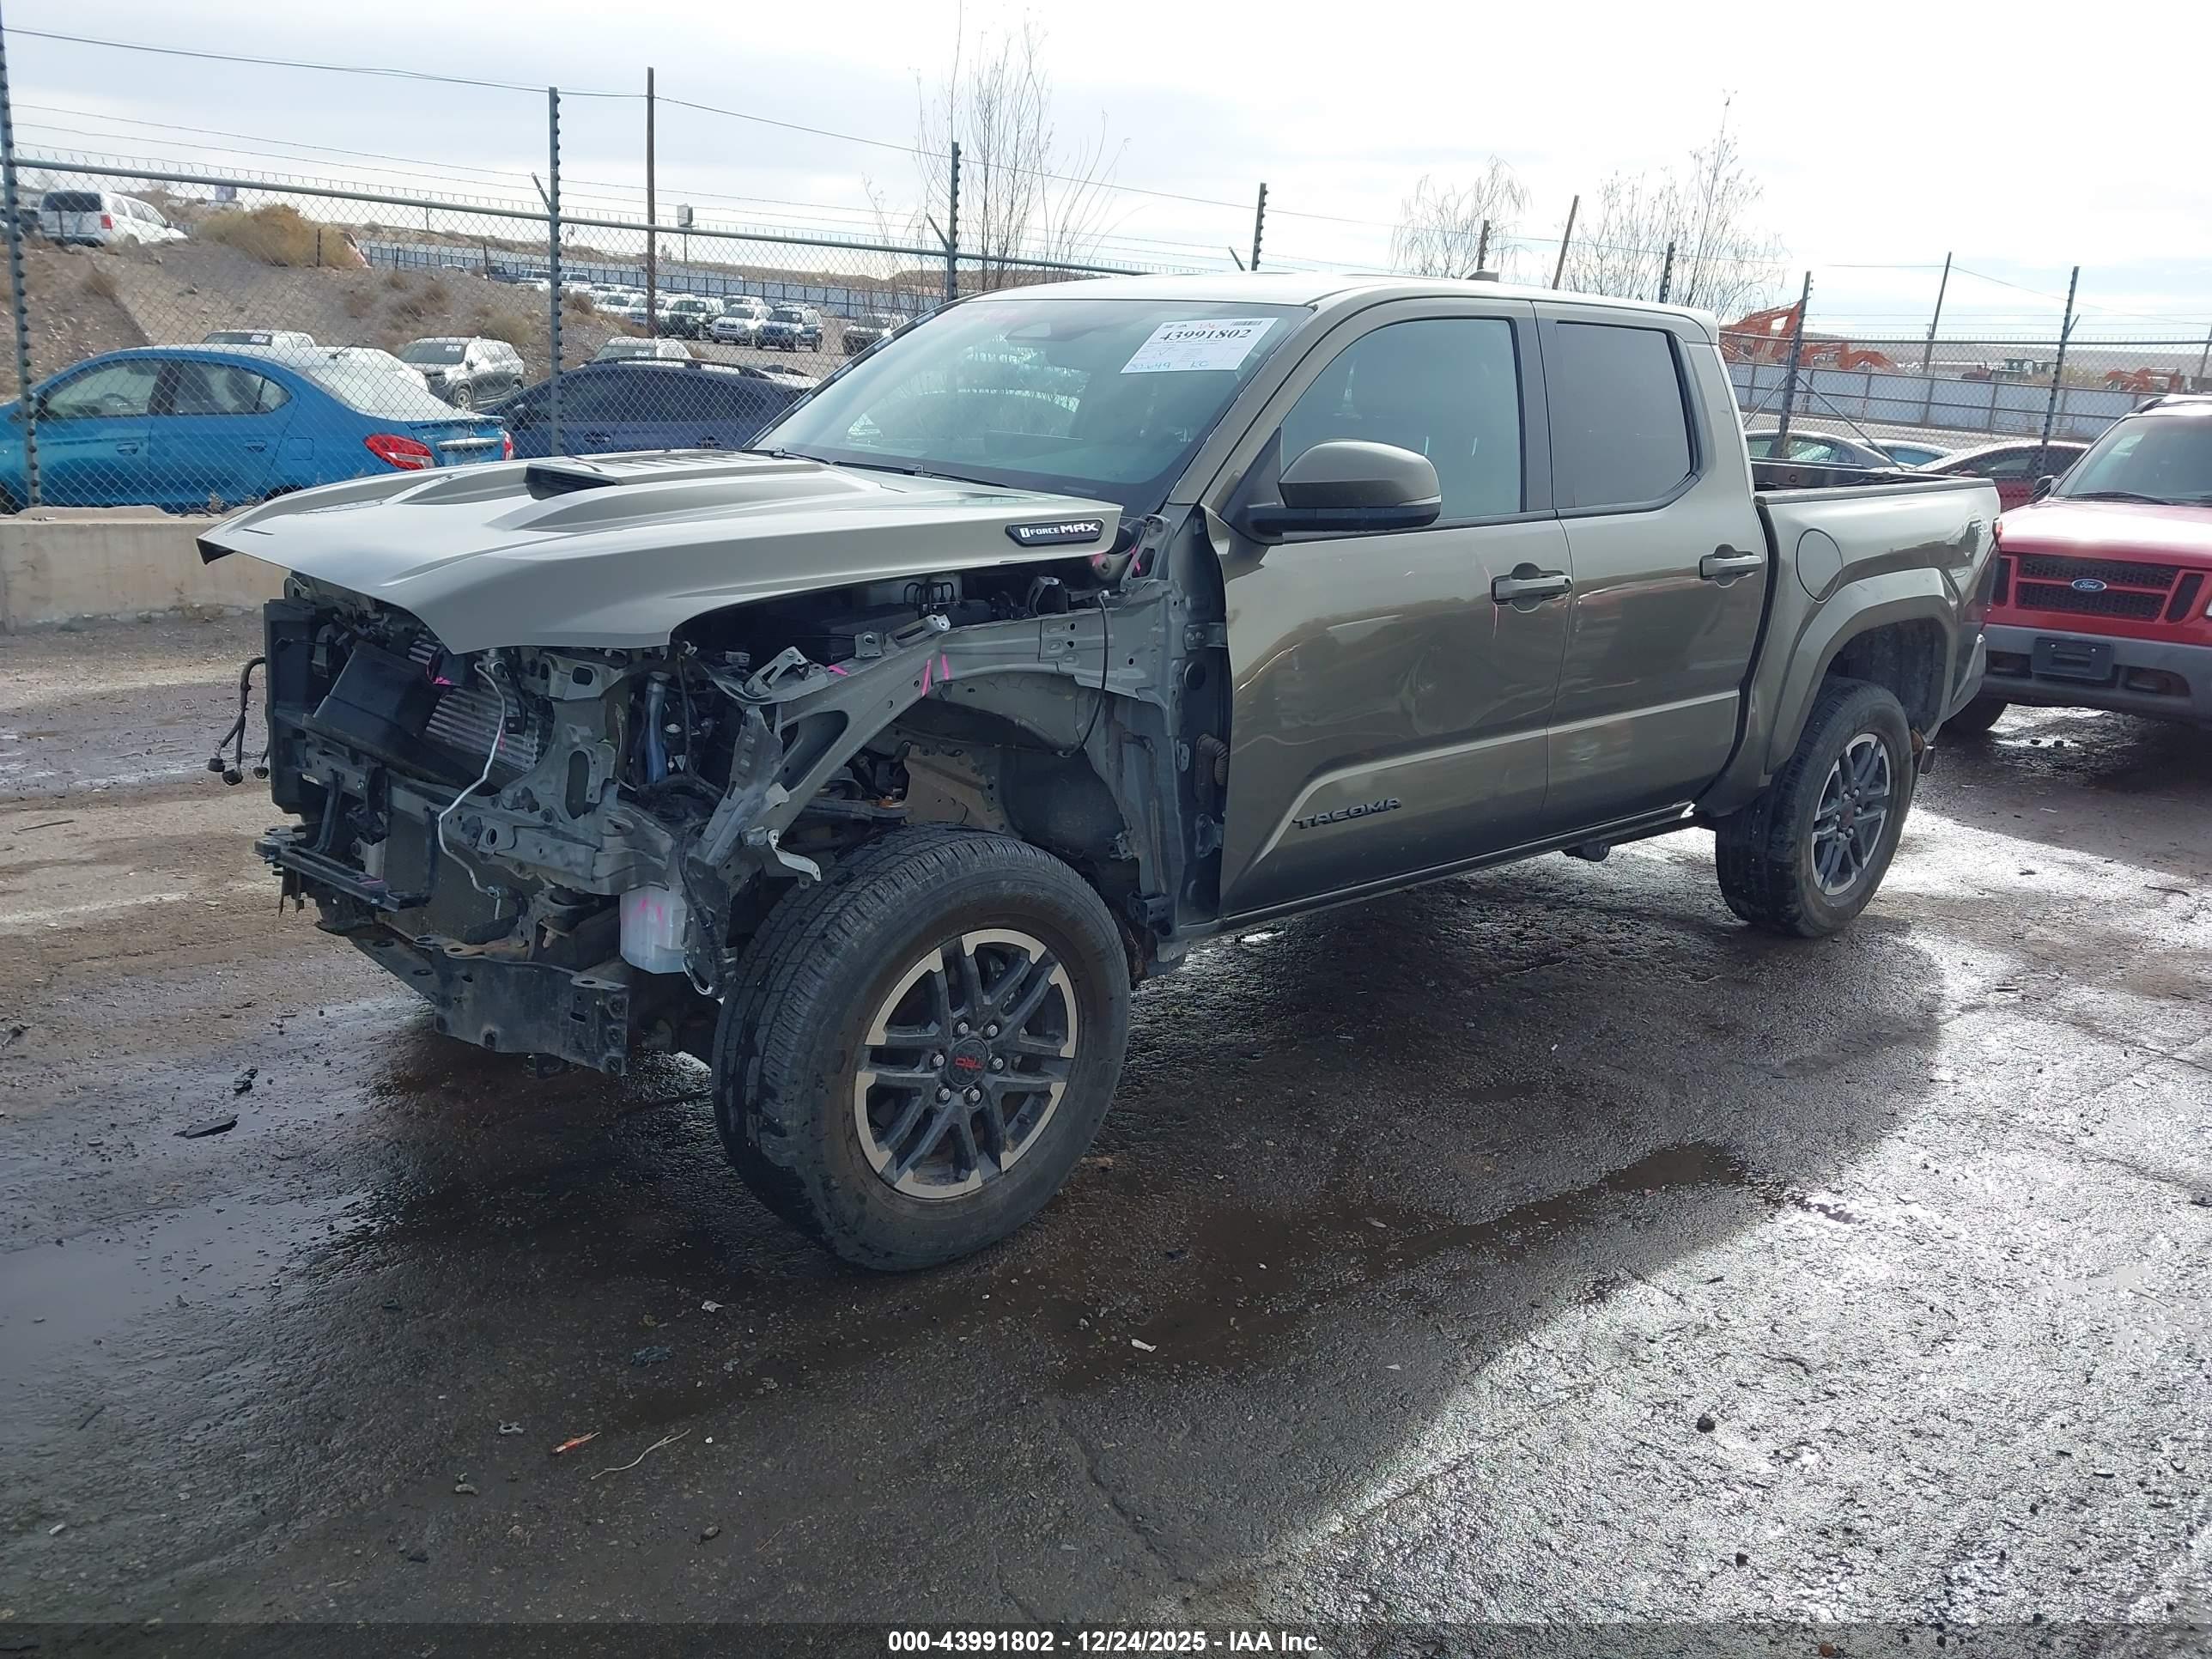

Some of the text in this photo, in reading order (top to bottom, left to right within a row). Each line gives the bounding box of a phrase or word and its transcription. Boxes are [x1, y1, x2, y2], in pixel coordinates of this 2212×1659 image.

[1159, 329, 1252, 342] 43991802
[2079, 580, 2099, 590] Ford
[1292, 797, 1402, 830] TACOMA
